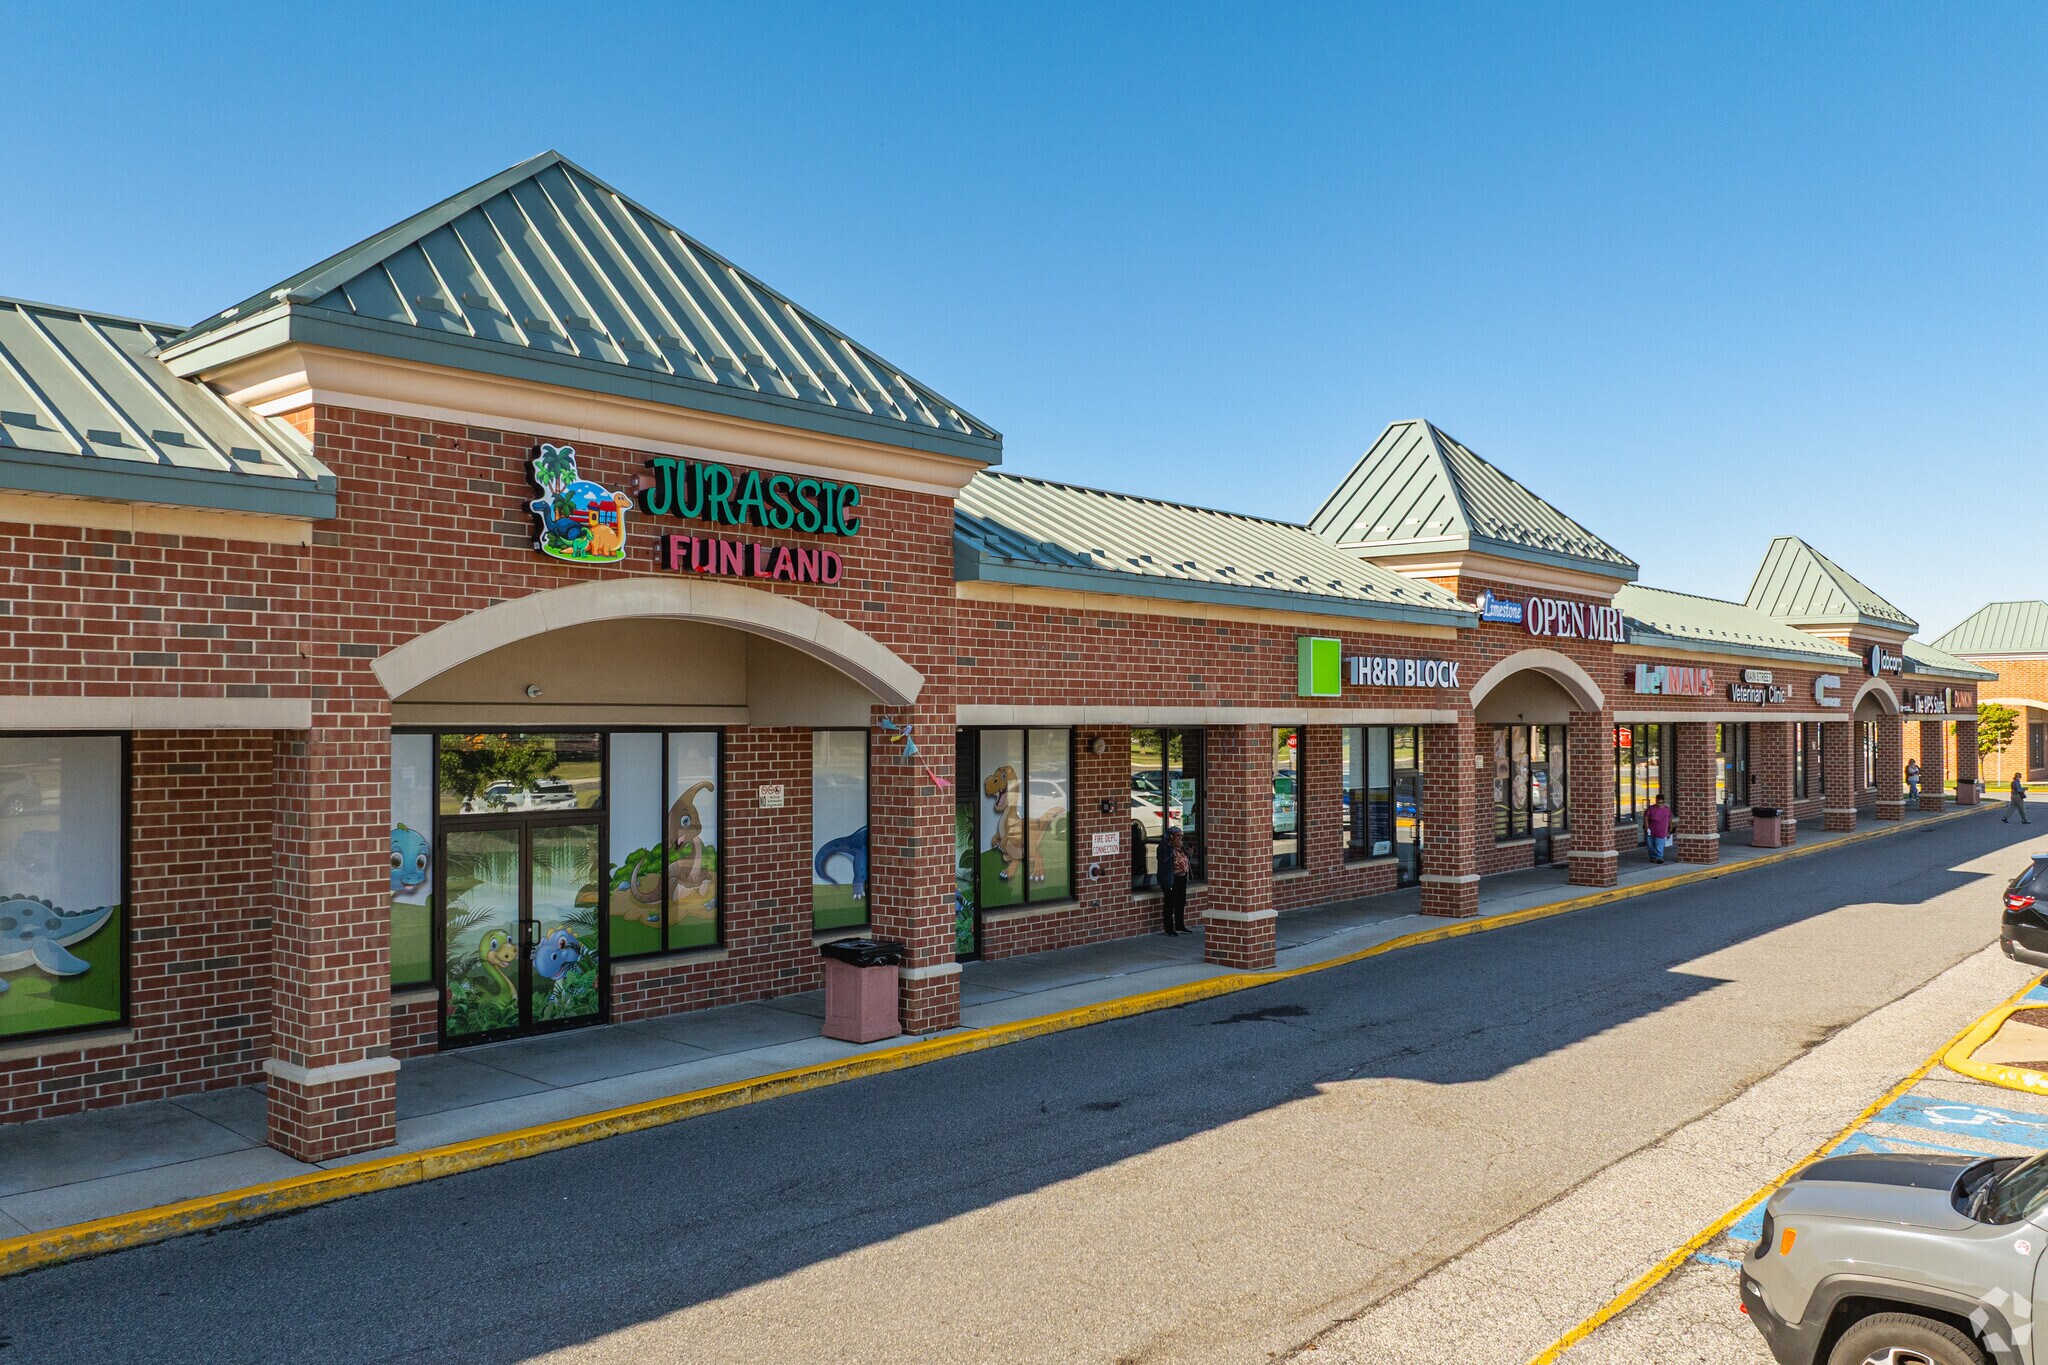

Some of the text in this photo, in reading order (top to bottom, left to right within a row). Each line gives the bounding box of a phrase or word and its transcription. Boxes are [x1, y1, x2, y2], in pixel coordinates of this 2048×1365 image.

[643, 456, 861, 537] JURASSIC
[668, 534, 844, 585] FUN LAND
[1483, 593, 1521, 619] Limestone
[1526, 596, 1626, 643] OPEN MRI
[1357, 656, 1460, 689] H&R BLOCK
[1881, 649, 1903, 676] labcorp
[1667, 665, 1715, 697] NAILS
[1732, 683, 1786, 707] Veterinary Clinic
[1092, 844, 1119, 856] CONNECTION
[1093, 833, 1118, 843] FIRE DEPT.
